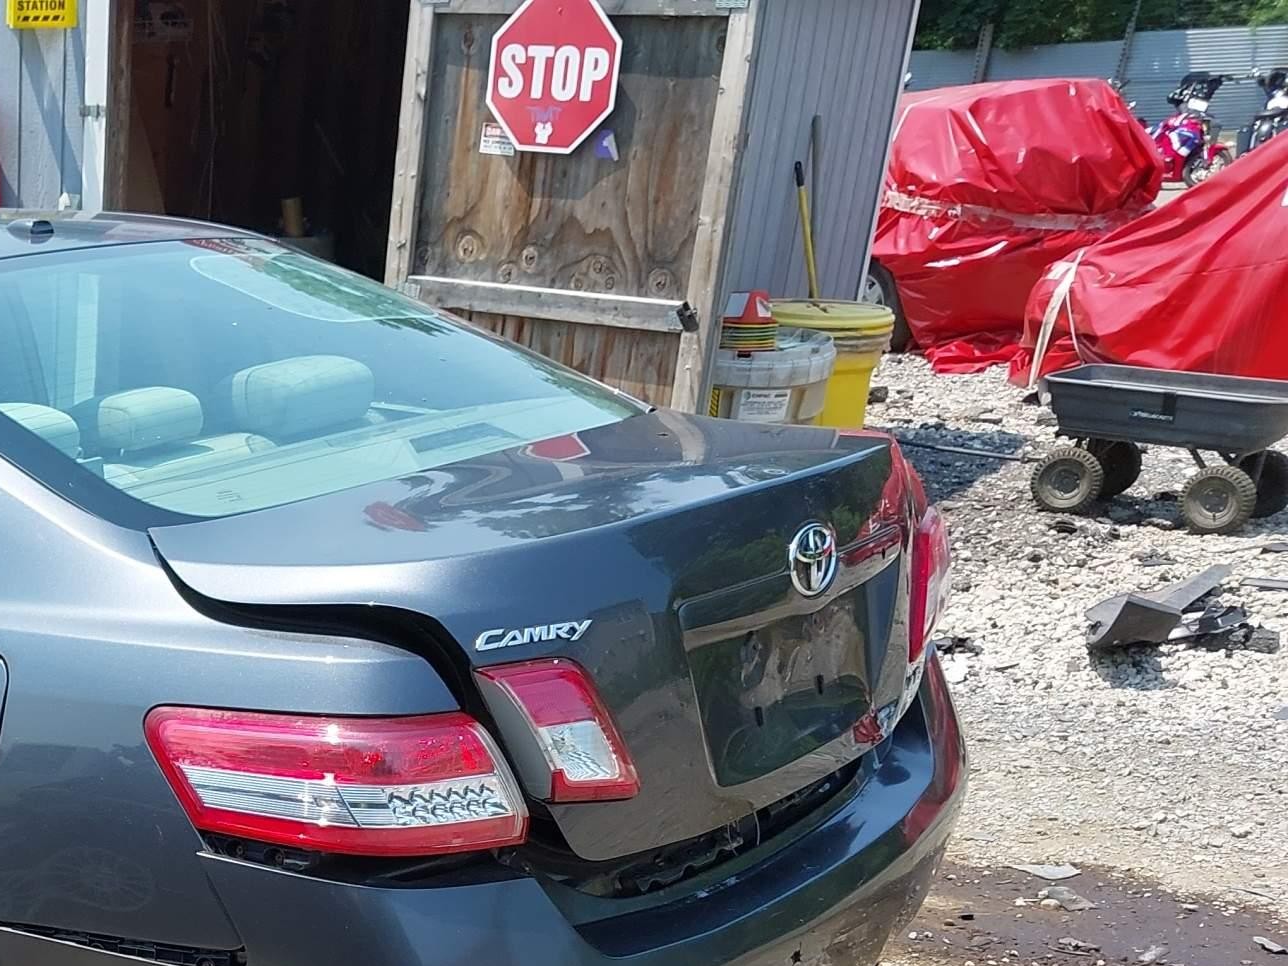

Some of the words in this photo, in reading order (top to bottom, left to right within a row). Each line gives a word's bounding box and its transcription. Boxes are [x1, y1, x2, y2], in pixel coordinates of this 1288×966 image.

[17, 0, 64, 11] STATION
[497, 43, 610, 102] STOP
[476, 619, 592, 651] CAMRY
